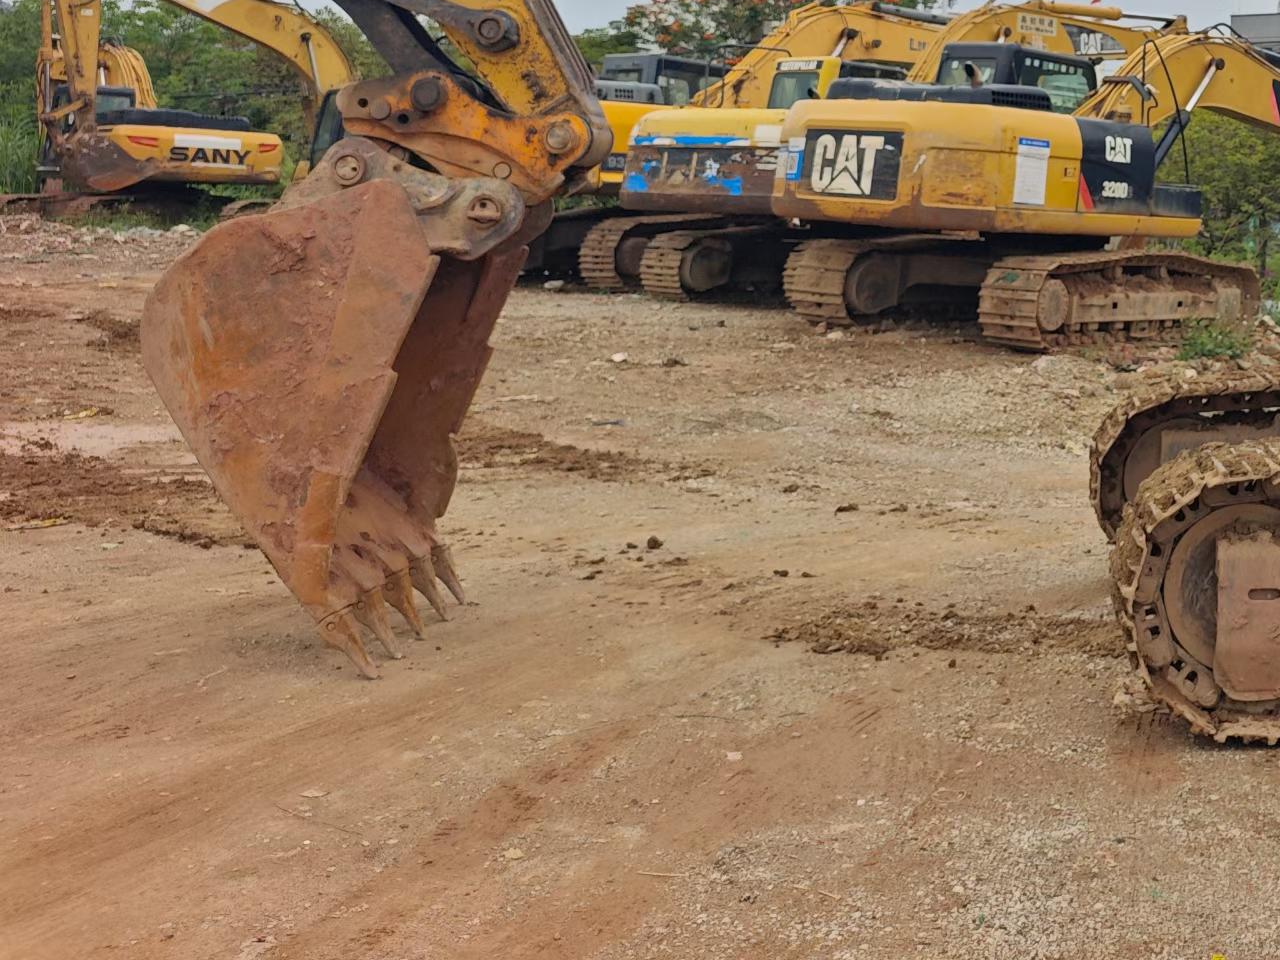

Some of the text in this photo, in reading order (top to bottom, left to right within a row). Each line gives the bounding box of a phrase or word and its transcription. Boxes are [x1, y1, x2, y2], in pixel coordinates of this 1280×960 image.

[1080, 33, 1103, 54] CAT
[169, 146, 252, 165] SANY
[1105, 135, 1133, 164] CAT
[811, 134, 885, 196] CAT
